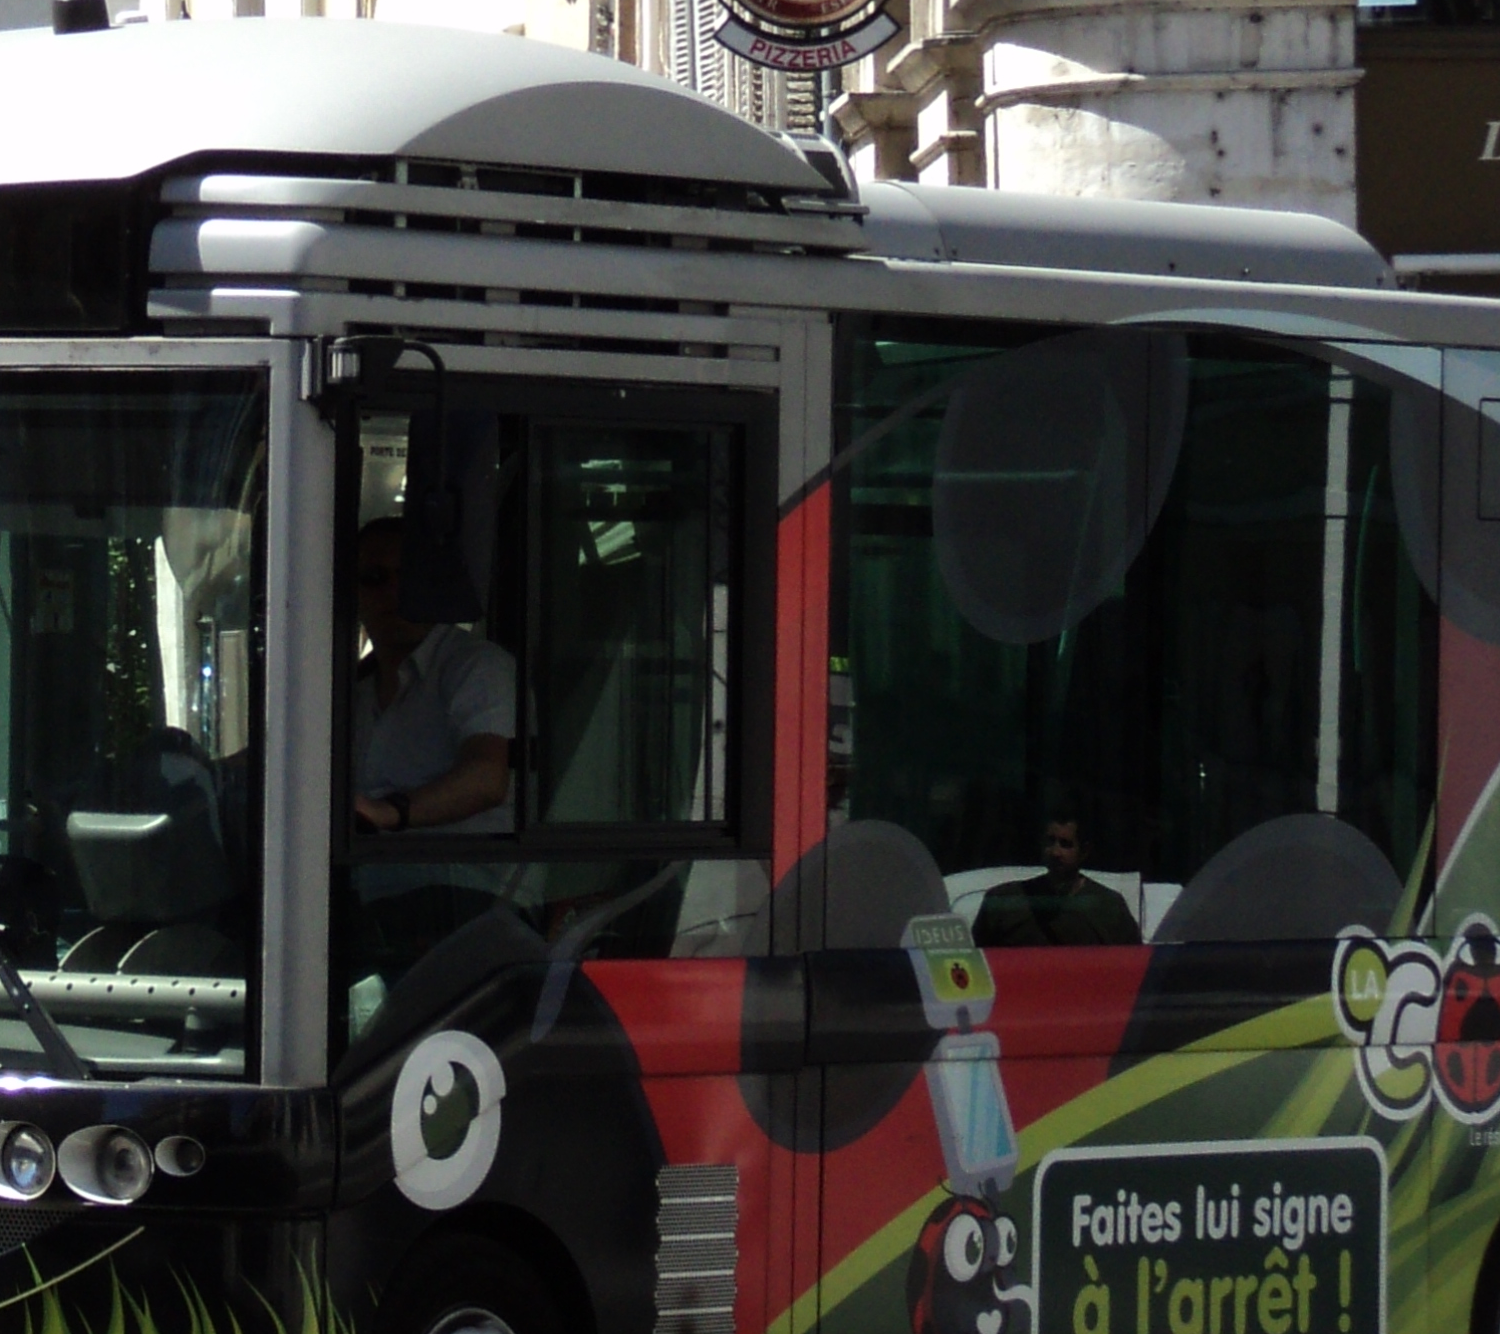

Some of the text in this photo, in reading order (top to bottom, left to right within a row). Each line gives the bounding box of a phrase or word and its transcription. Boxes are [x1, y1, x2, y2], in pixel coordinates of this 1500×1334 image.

[749, 38, 857, 69] PIZZERIA
[1351, 969, 1379, 1001] LA
[1071, 1180, 1354, 1251] Faites lui signe
[1338, 1249, 1352, 1334] !
